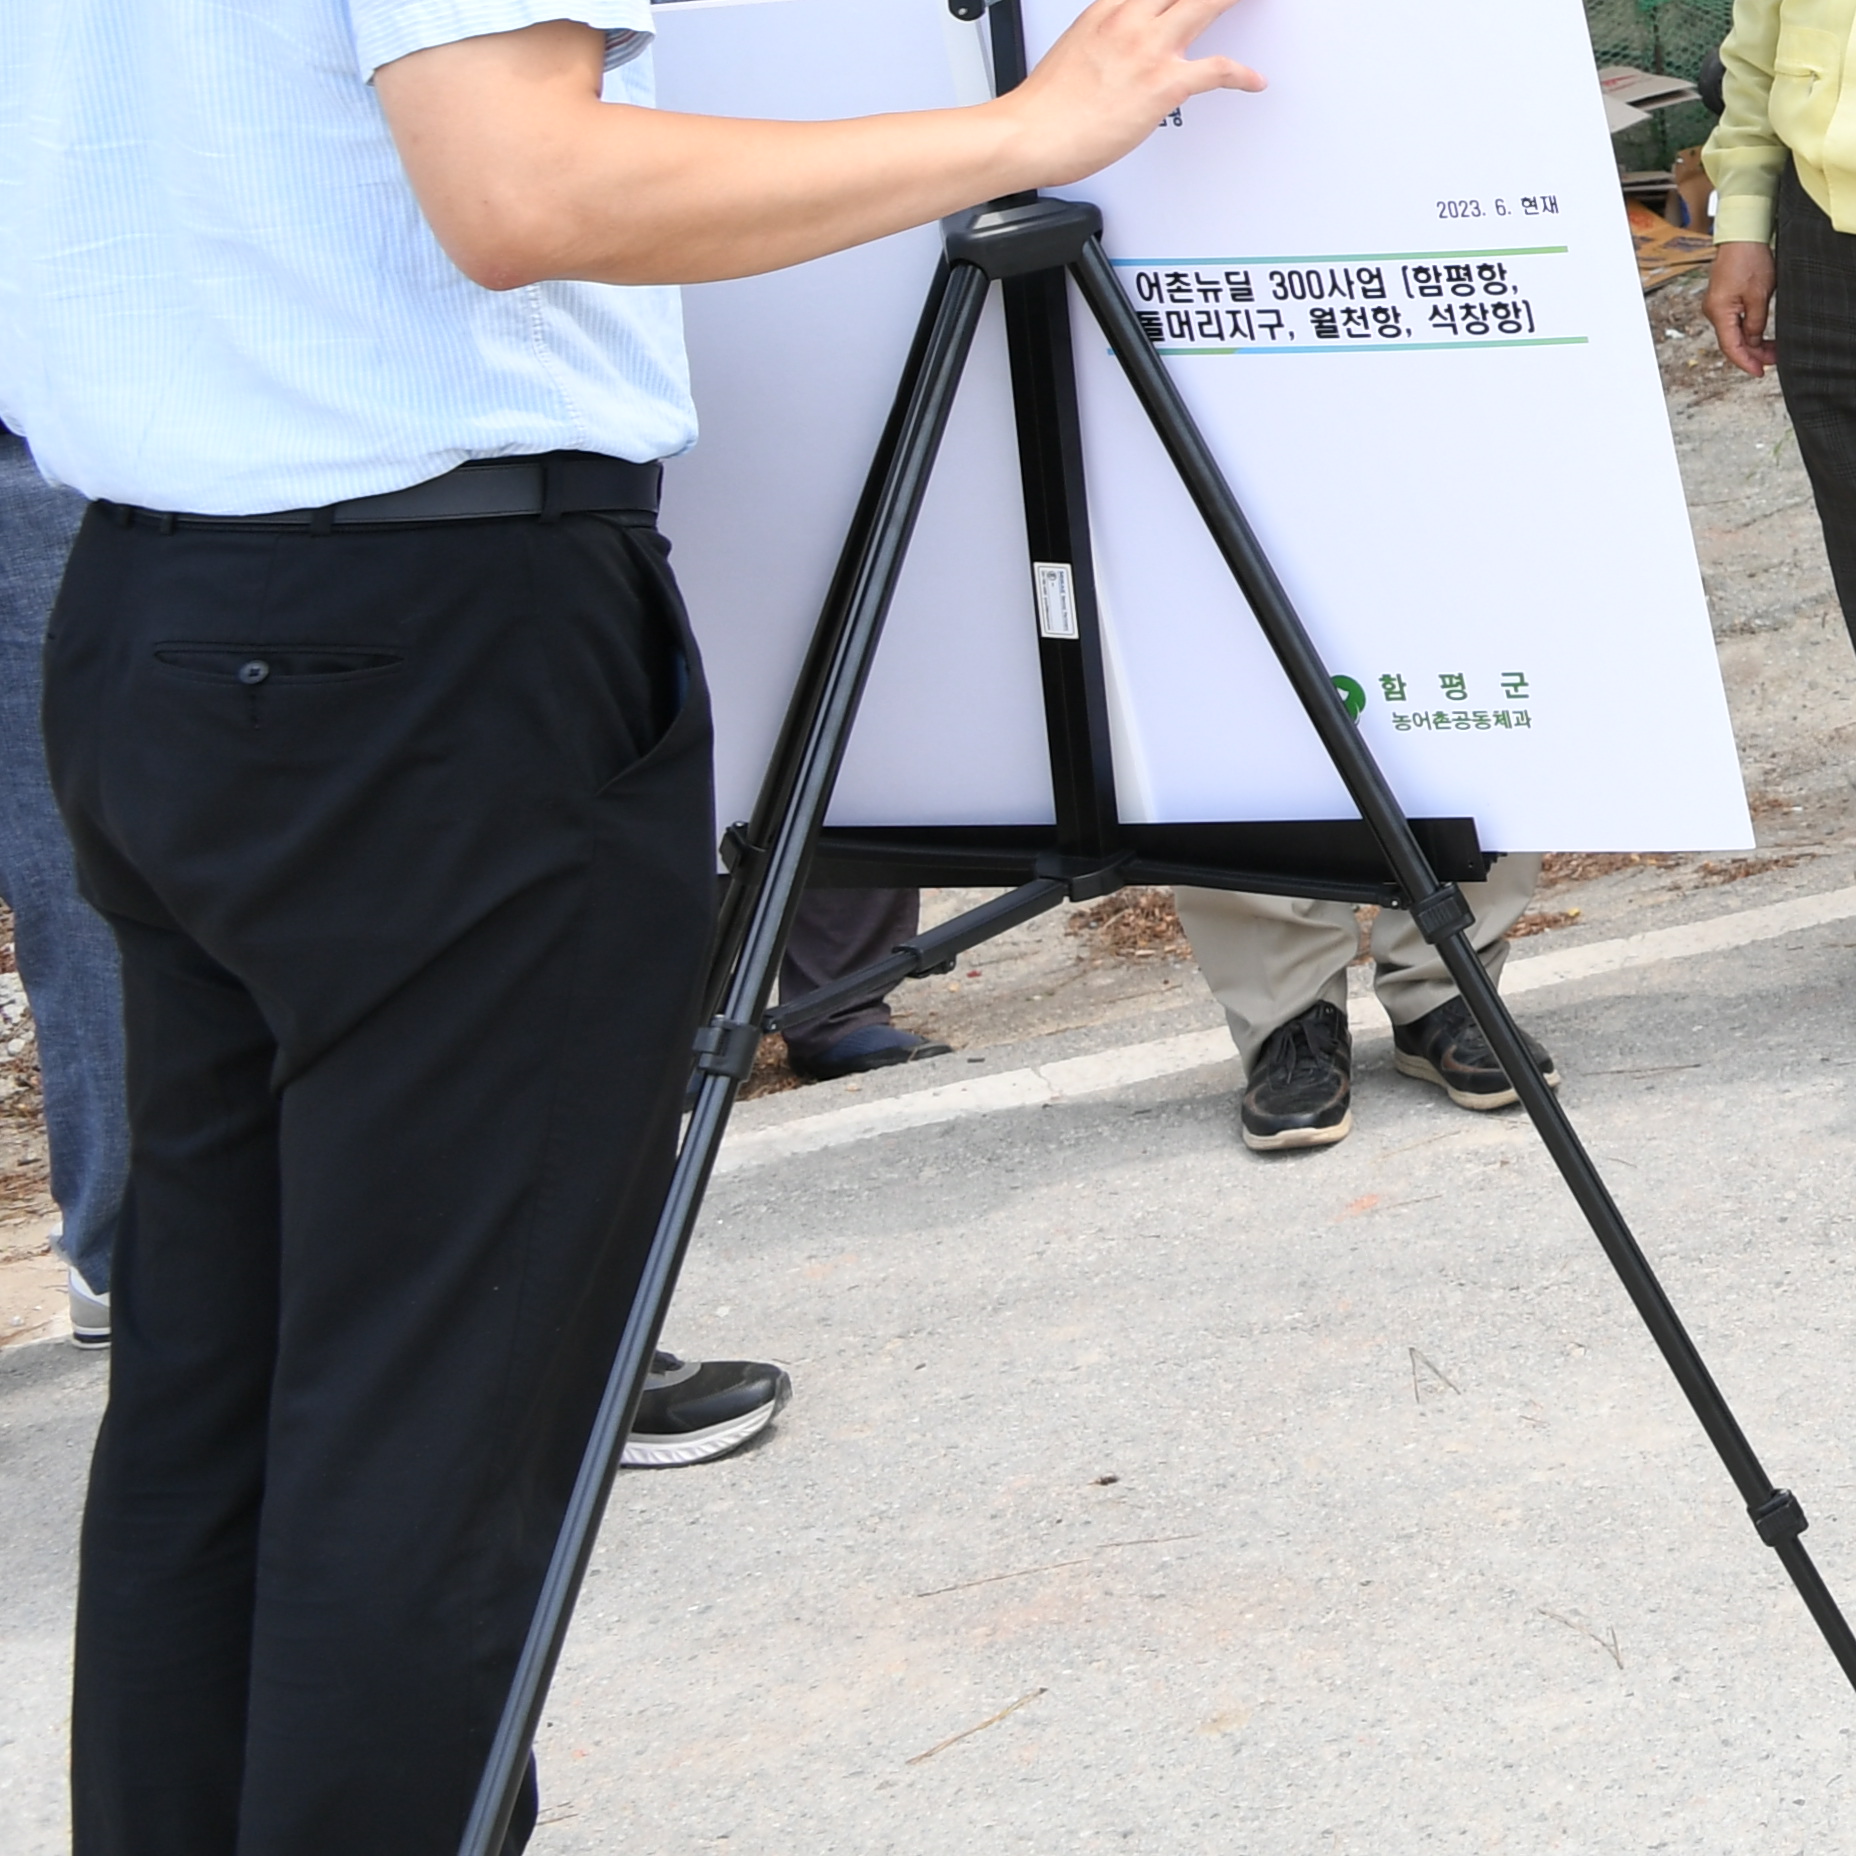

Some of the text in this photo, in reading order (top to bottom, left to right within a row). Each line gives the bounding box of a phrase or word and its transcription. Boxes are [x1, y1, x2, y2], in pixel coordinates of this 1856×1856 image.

[1436, 194, 1560, 220] 2023. 6. 현재
[1135, 269, 1256, 305] 어촌뉴딜
[1269, 266, 1388, 301] 300사업
[1138, 307, 1296, 343] 돌머리지구,
[1309, 304, 1413, 340] 월천항,
[1391, 709, 1533, 732] 농어촌공동체과
